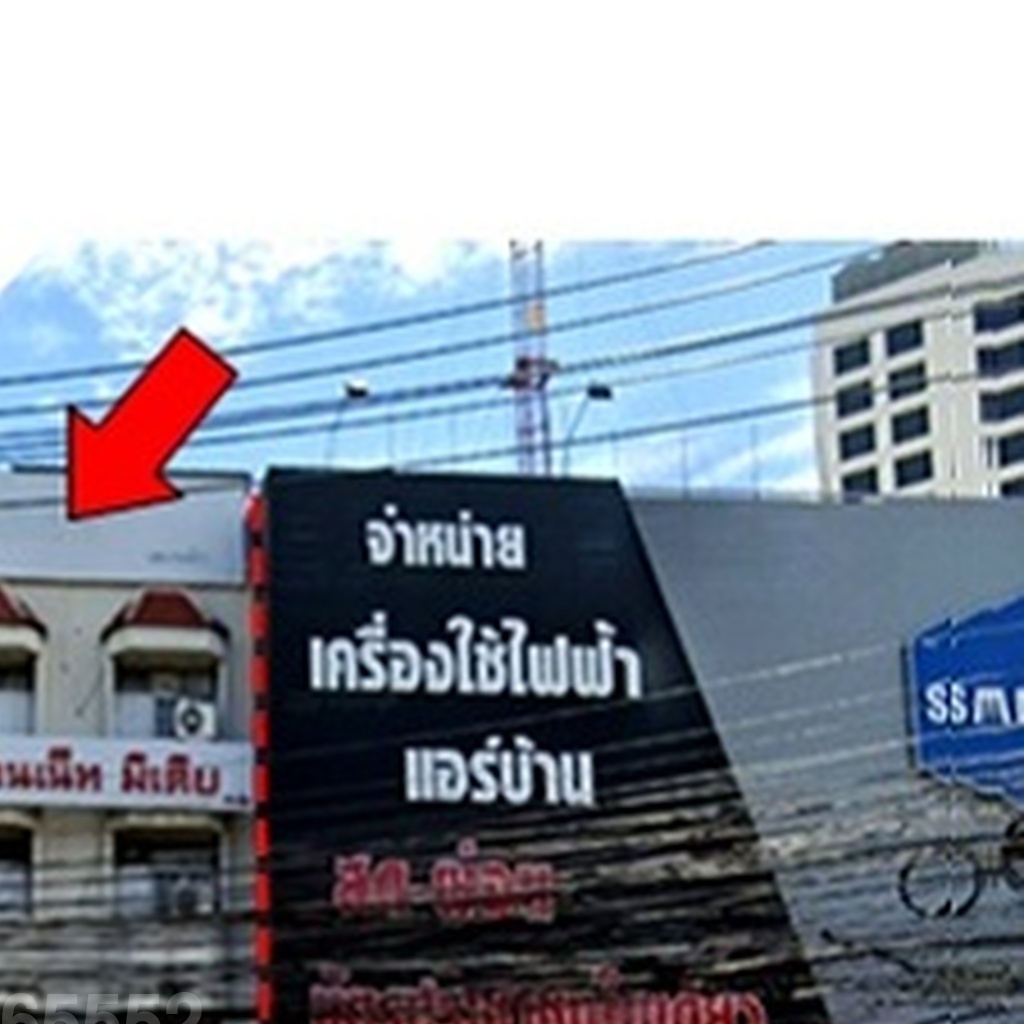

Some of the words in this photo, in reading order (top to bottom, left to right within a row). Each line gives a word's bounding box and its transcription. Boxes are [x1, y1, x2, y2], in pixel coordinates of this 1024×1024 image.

[366, 504, 526, 568] จำหน่าย
[310, 611, 642, 699] เครื่องใช้ไฟฟ้า
[405, 735, 594, 806] แอร์บ้าน
